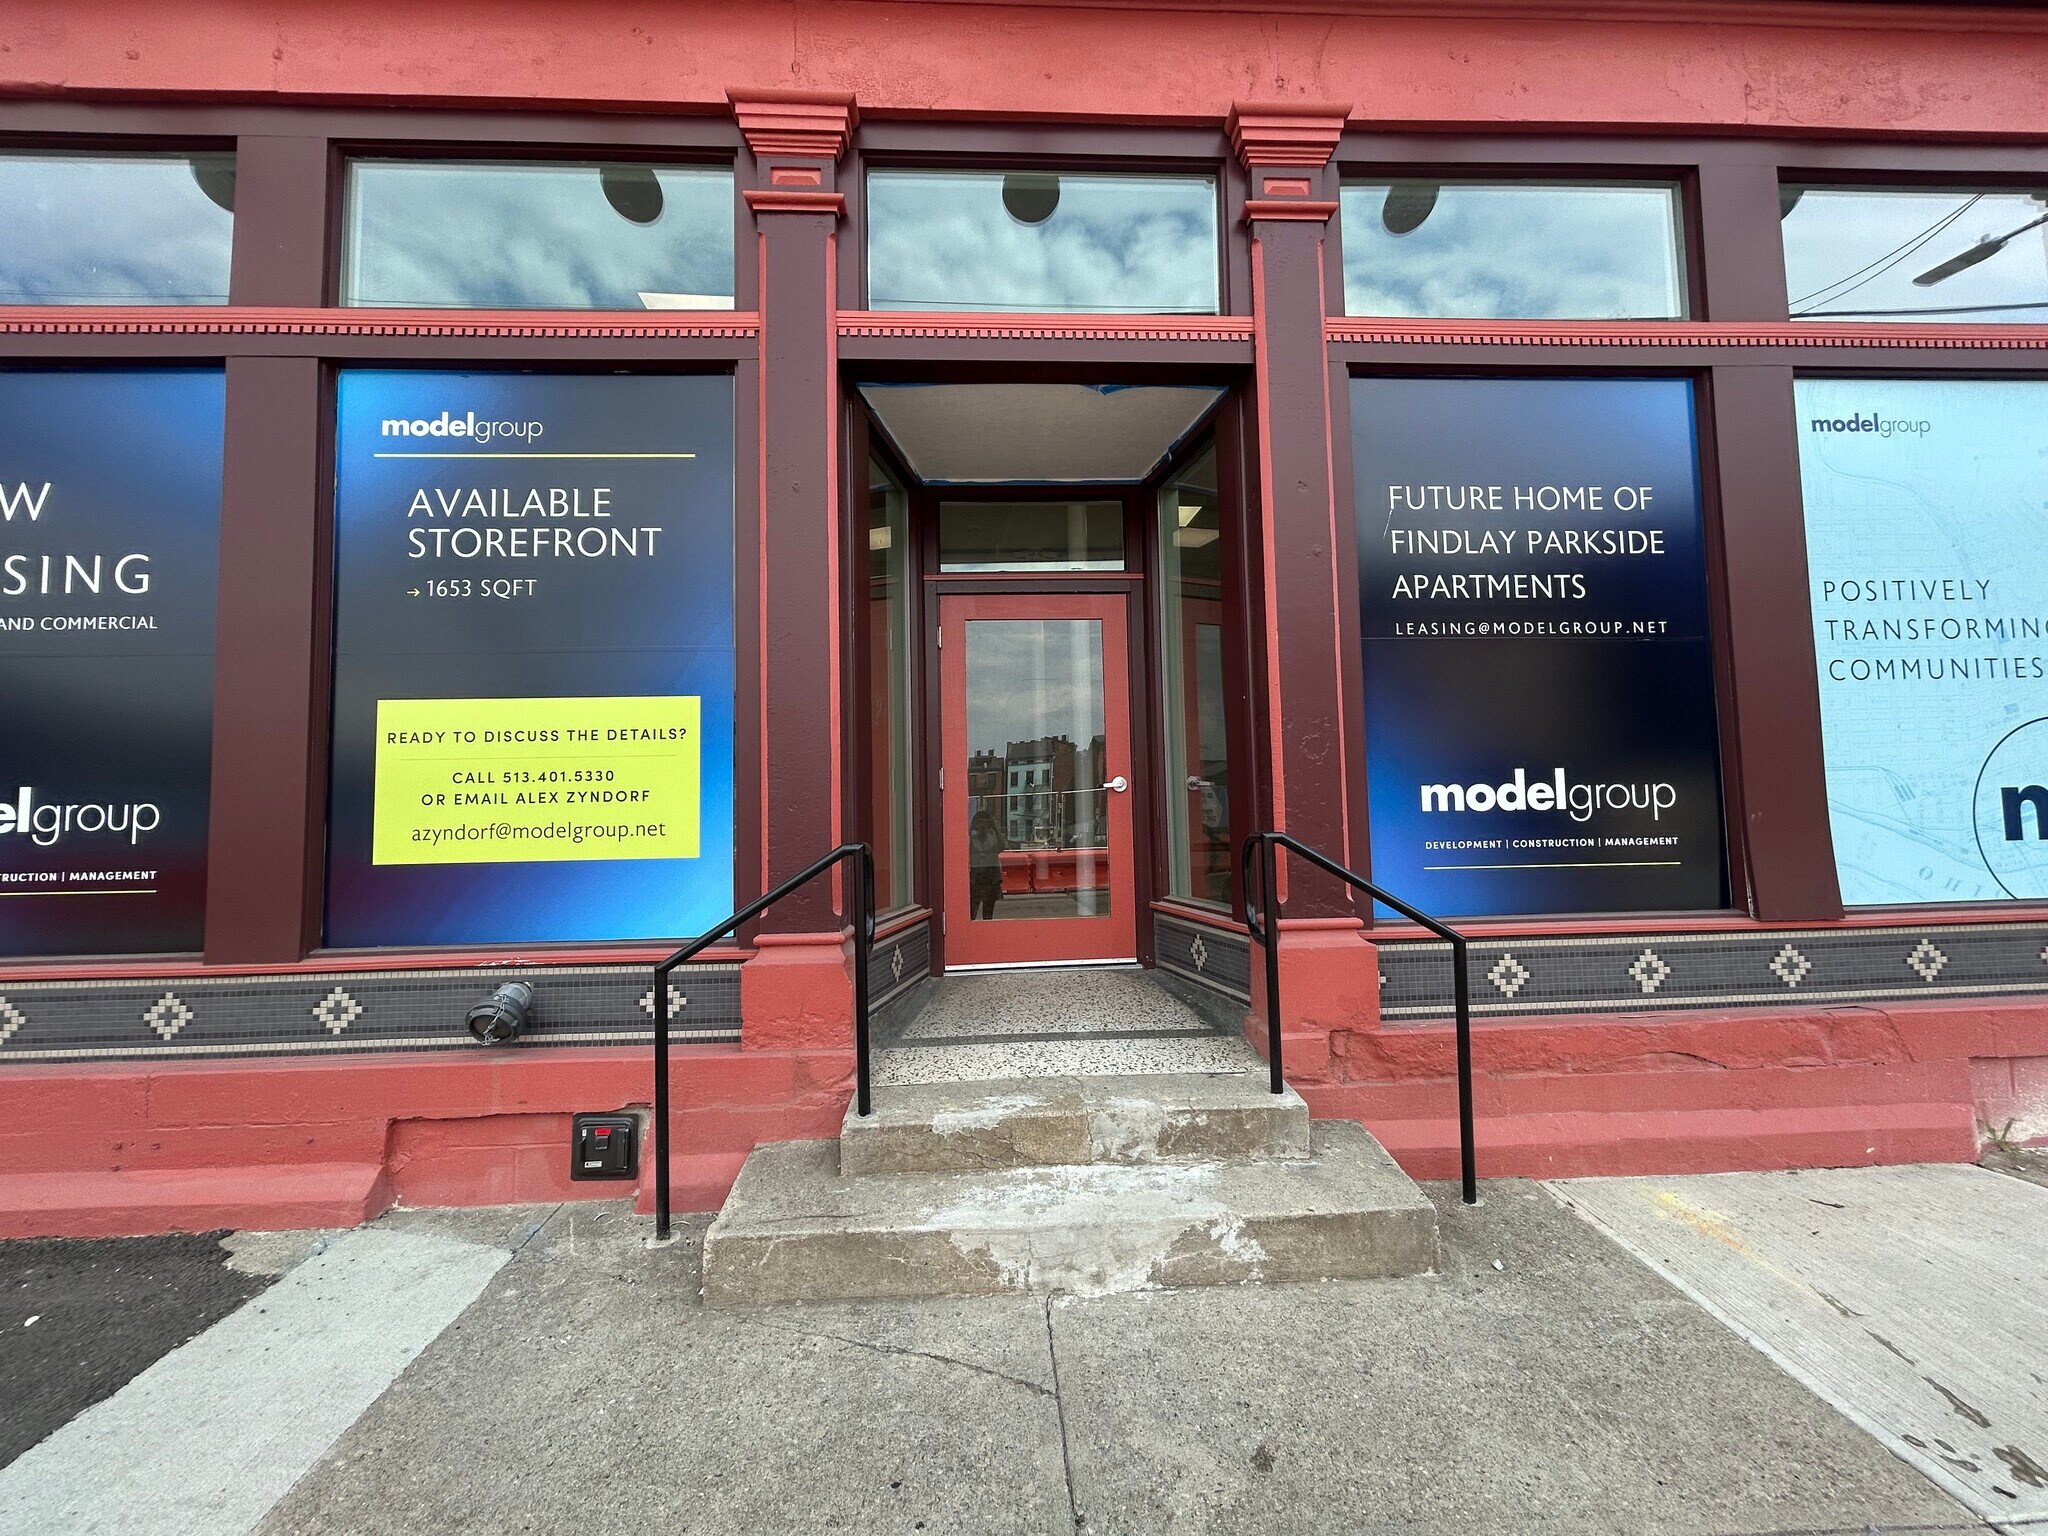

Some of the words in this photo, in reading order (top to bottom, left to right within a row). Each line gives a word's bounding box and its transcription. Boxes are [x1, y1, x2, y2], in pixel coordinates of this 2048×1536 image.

[381, 411, 543, 444] modelgroup
[1811, 412, 1931, 438] modelgroup
[407, 488, 611, 518] AVAILABLE
[1388, 485, 1503, 510] FUTURE
[1513, 486, 1604, 511] HOME
[1613, 486, 1653, 511] OF
[408, 527, 663, 558] STOREFRONT
[1390, 529, 1517, 554] FINDLAY
[1526, 529, 1665, 555] PARKSIDE
[2, 553, 149, 596] SING
[1392, 573, 1586, 599] APARTMENTS
[426, 579, 472, 597] 1653
[480, 579, 538, 600] SQFT
[1823, 579, 1990, 602] POSITIVELY
[40, 615, 158, 631] COMMERCIAL
[1395, 621, 1667, 635] LEASING@MODELGROUP.NET
[1824, 617, 2048, 641] TRANSFORMIN
[1829, 656, 2044, 681] COMMUNITIES
[387, 731, 446, 744] READY
[453, 731, 476, 743] TO
[484, 730, 559, 743] DISCUSS
[566, 729, 599, 742] THE
[607, 728, 687, 741] DETAILS?
[452, 771, 495, 784] CALL
[503, 770, 614, 784] 513.401.5330
[421, 793, 446, 806] OR
[454, 792, 508, 806] EMAIL
[515, 791, 559, 805] ALEX
[566, 790, 650, 803] ZYNDORF
[1420, 767, 1676, 822] modelgroup
[411, 821, 666, 846] azyndorf@modelgroup.net
[1425, 840, 1503, 850] DEVELOPMENT
[1512, 838, 1595, 848] CONSTRUCTION
[1604, 836, 1679, 847] MANAGEMENT
[69, 870, 157, 881] MANAGEMENT
